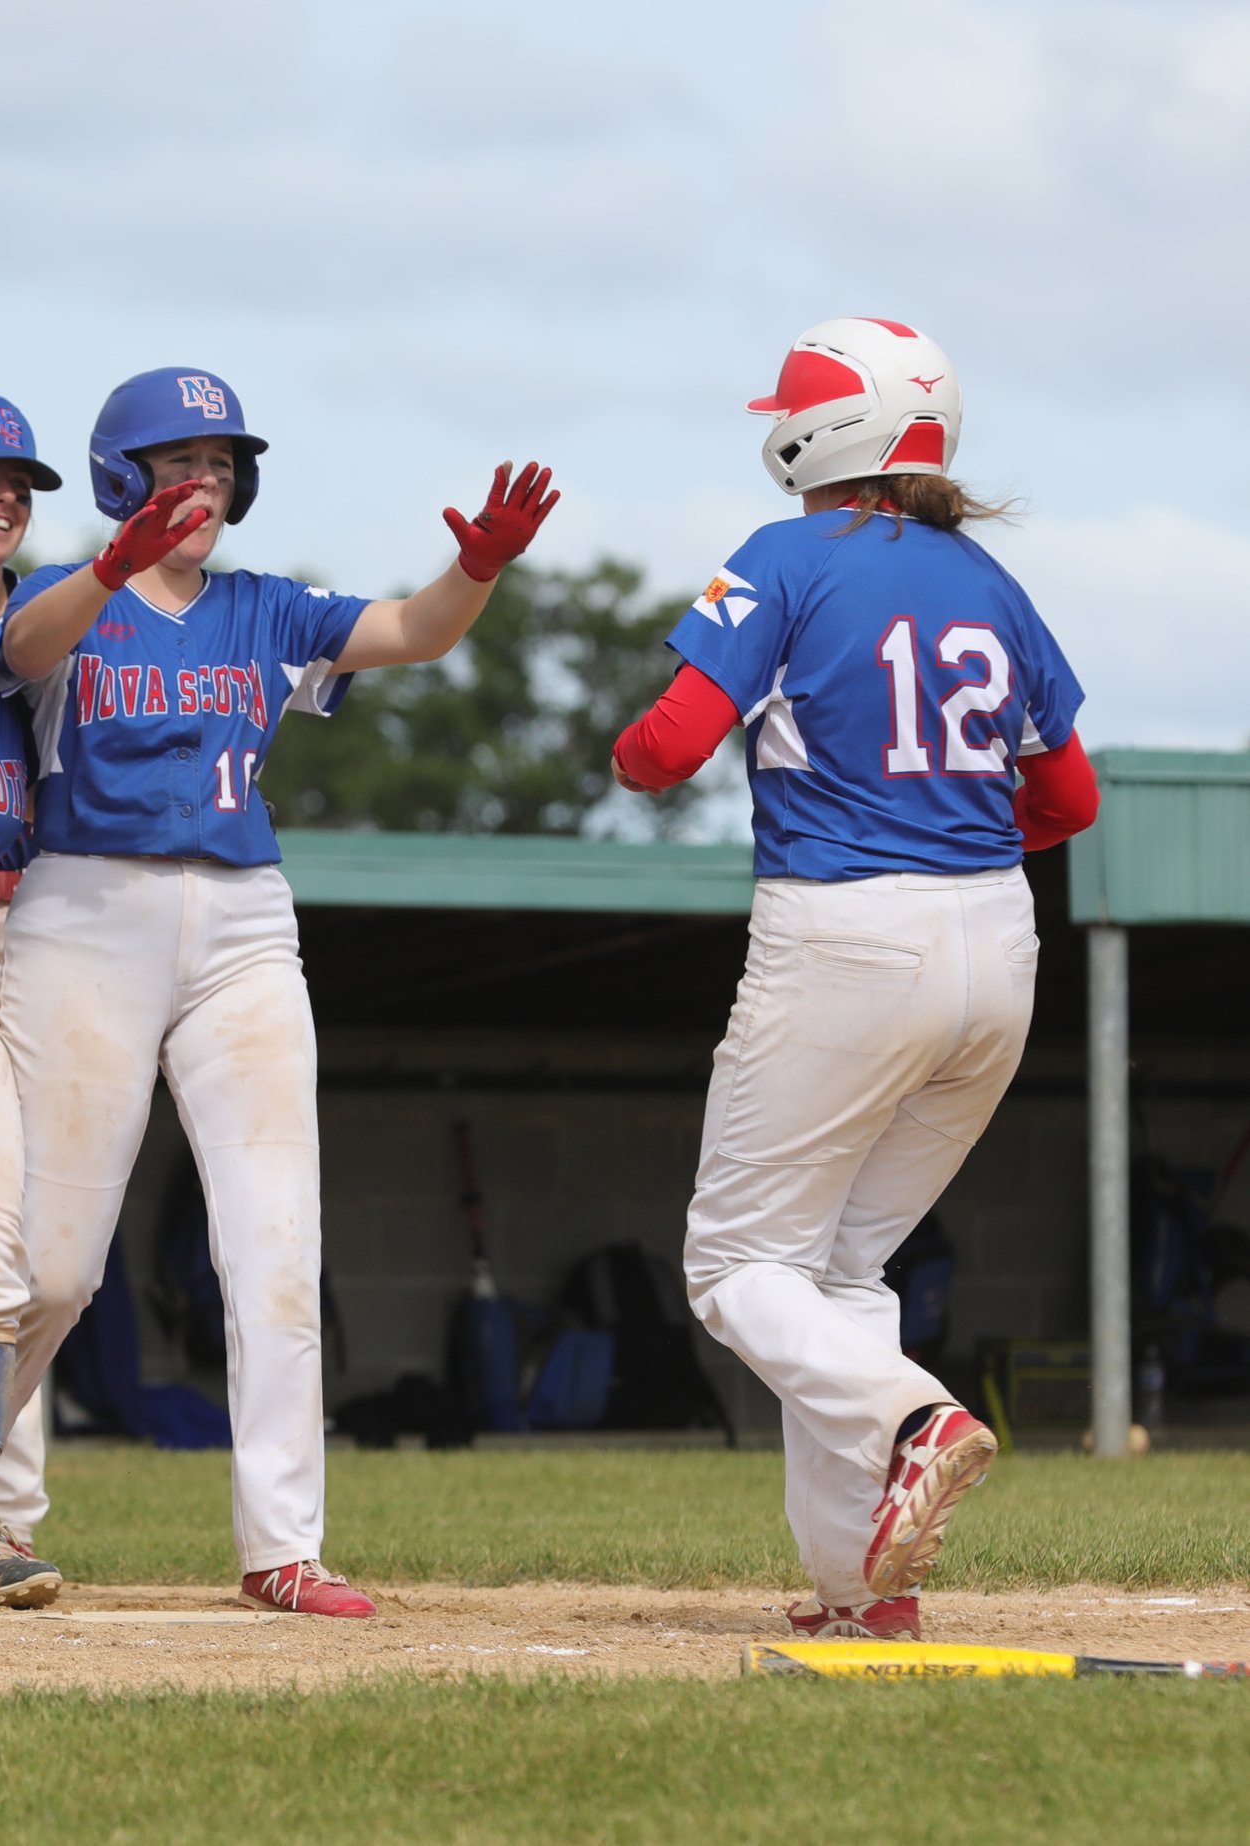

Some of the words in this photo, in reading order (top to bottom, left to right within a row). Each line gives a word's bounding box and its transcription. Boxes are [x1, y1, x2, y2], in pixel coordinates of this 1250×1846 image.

[177, 376, 228, 420] NS
[77, 653, 168, 728] NOVA
[877, 614, 1013, 779] 12
